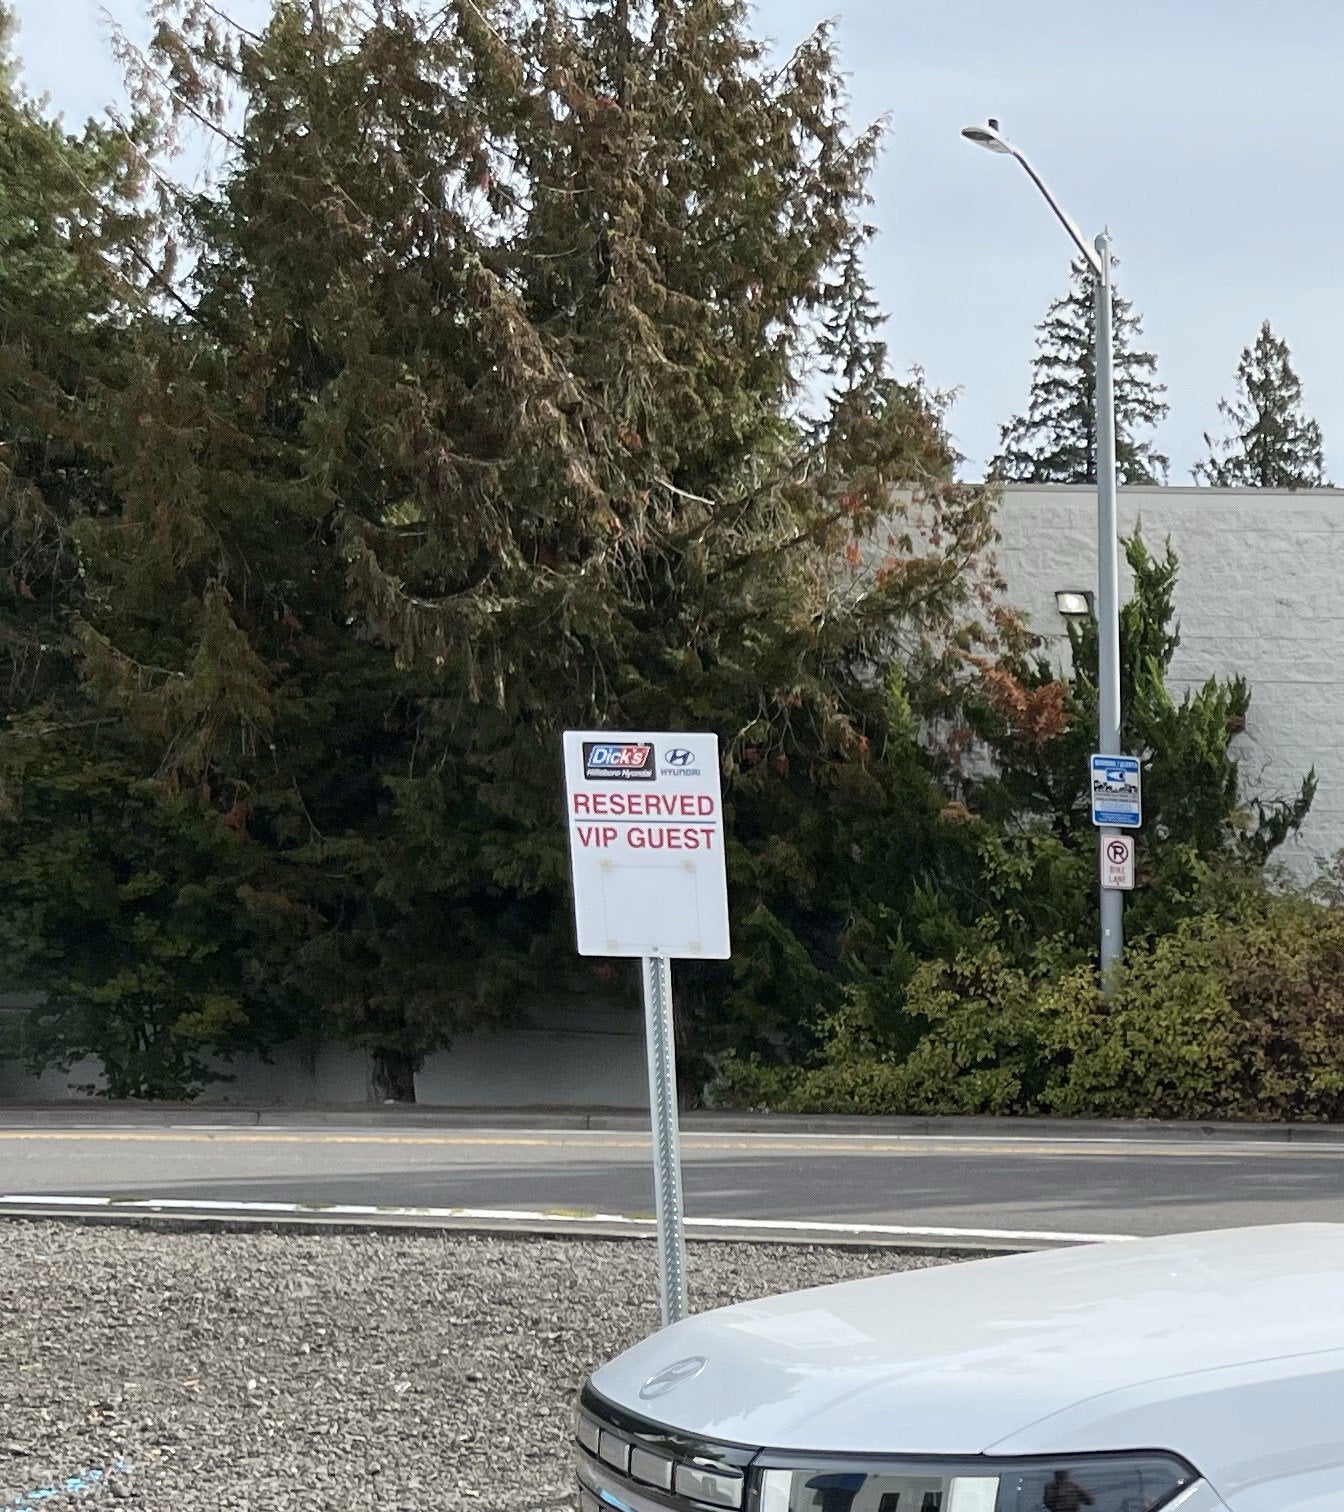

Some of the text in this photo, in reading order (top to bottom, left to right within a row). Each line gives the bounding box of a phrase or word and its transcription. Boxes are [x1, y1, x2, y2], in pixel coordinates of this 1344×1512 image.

[592, 747, 644, 766] Dick's
[573, 793, 714, 816] RESERVED
[577, 827, 715, 849] VIP GUEST
